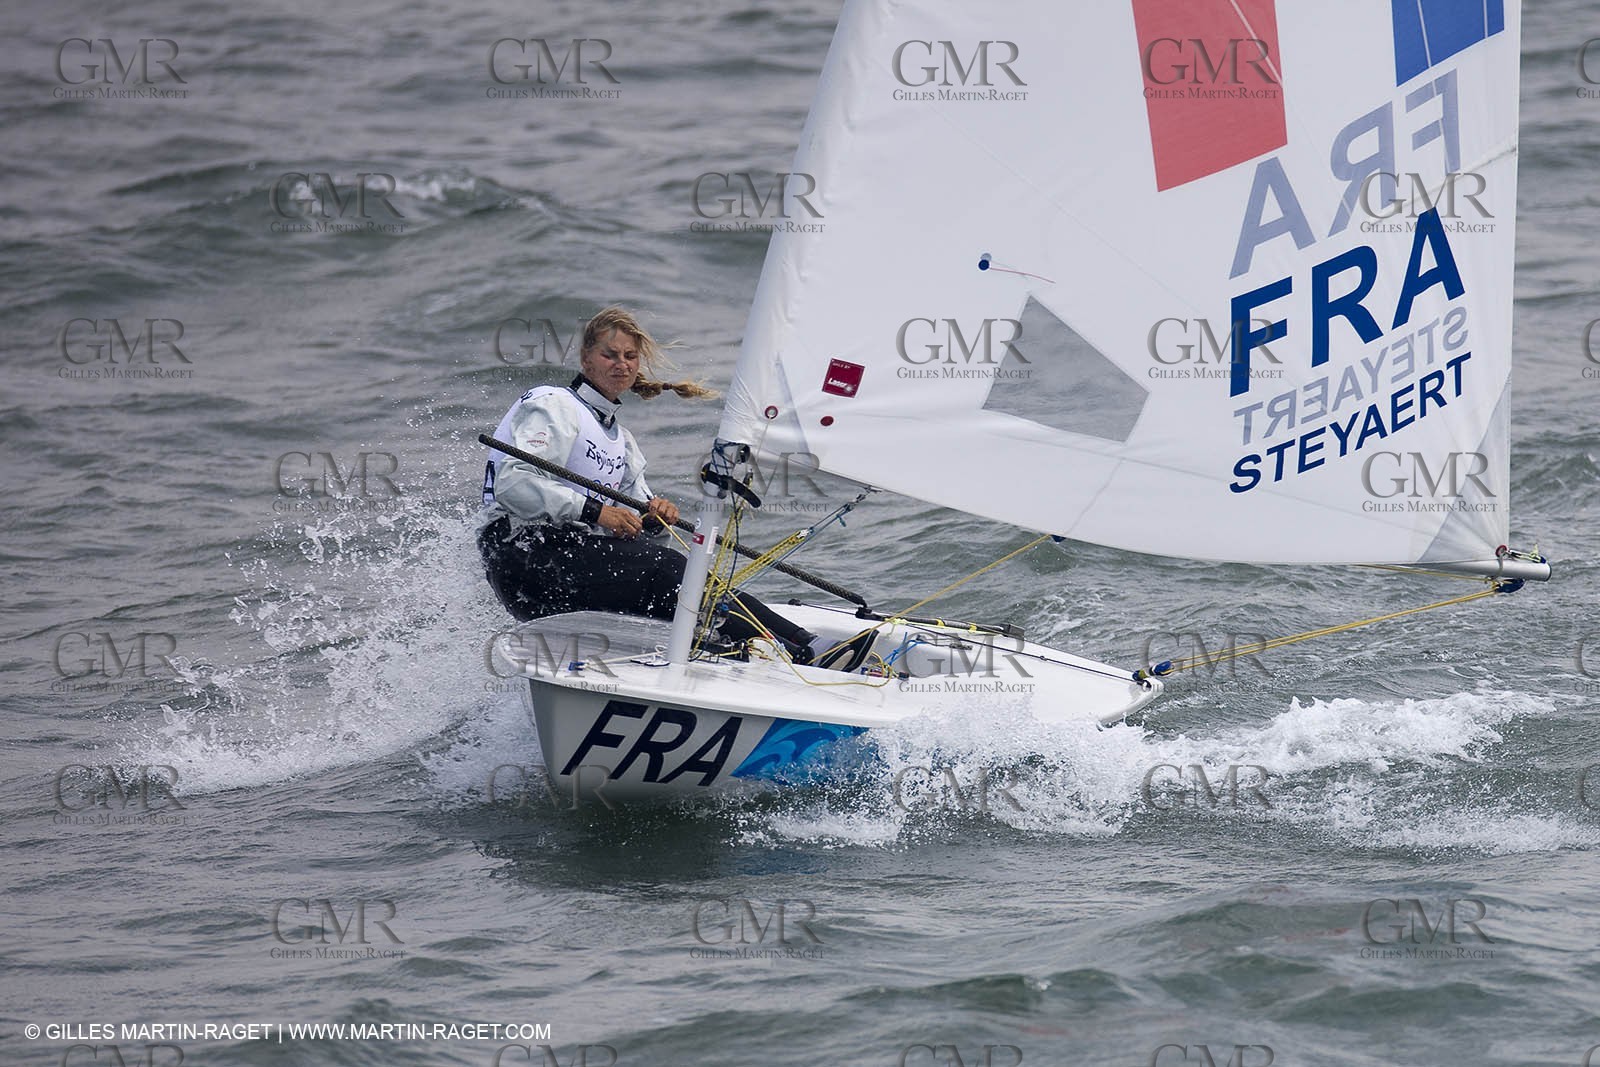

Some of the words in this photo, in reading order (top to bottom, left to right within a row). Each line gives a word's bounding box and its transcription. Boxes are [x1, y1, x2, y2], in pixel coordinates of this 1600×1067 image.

[1230, 206, 1465, 397] FRA
[1229, 351, 1471, 493] STEYAERT
[560, 699, 743, 787] FRA
